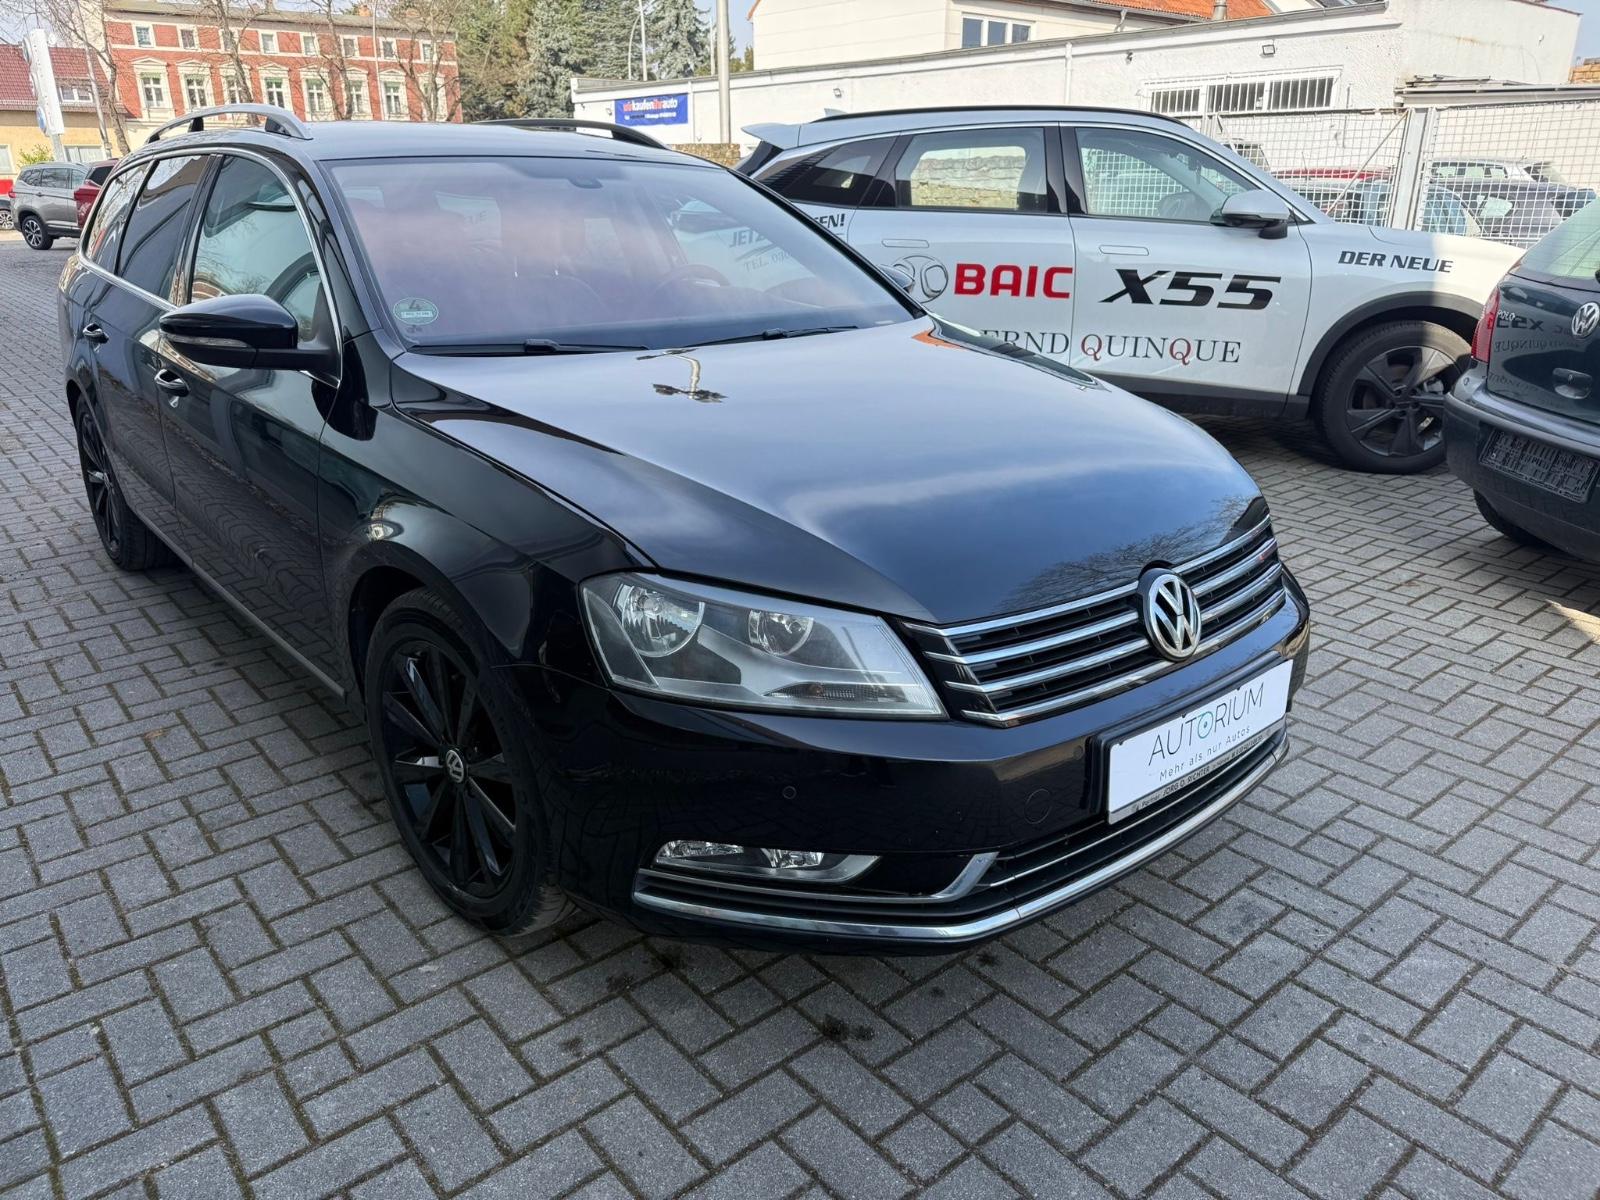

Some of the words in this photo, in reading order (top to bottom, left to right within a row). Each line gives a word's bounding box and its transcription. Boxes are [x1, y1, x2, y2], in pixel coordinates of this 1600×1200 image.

[954, 263, 1073, 299] BAIC
[1338, 250, 1387, 267] DER
[1390, 255, 1454, 273] NEUE
[1098, 268, 1281, 310] X55
[1081, 333, 1241, 366] QUINQUE
[1148, 682, 1264, 767] AUTORIUM
[1159, 761, 1185, 782] Mehr
[1189, 752, 1203, 767] als
[1207, 741, 1222, 756] nur
[1225, 725, 1251, 745] Autos
